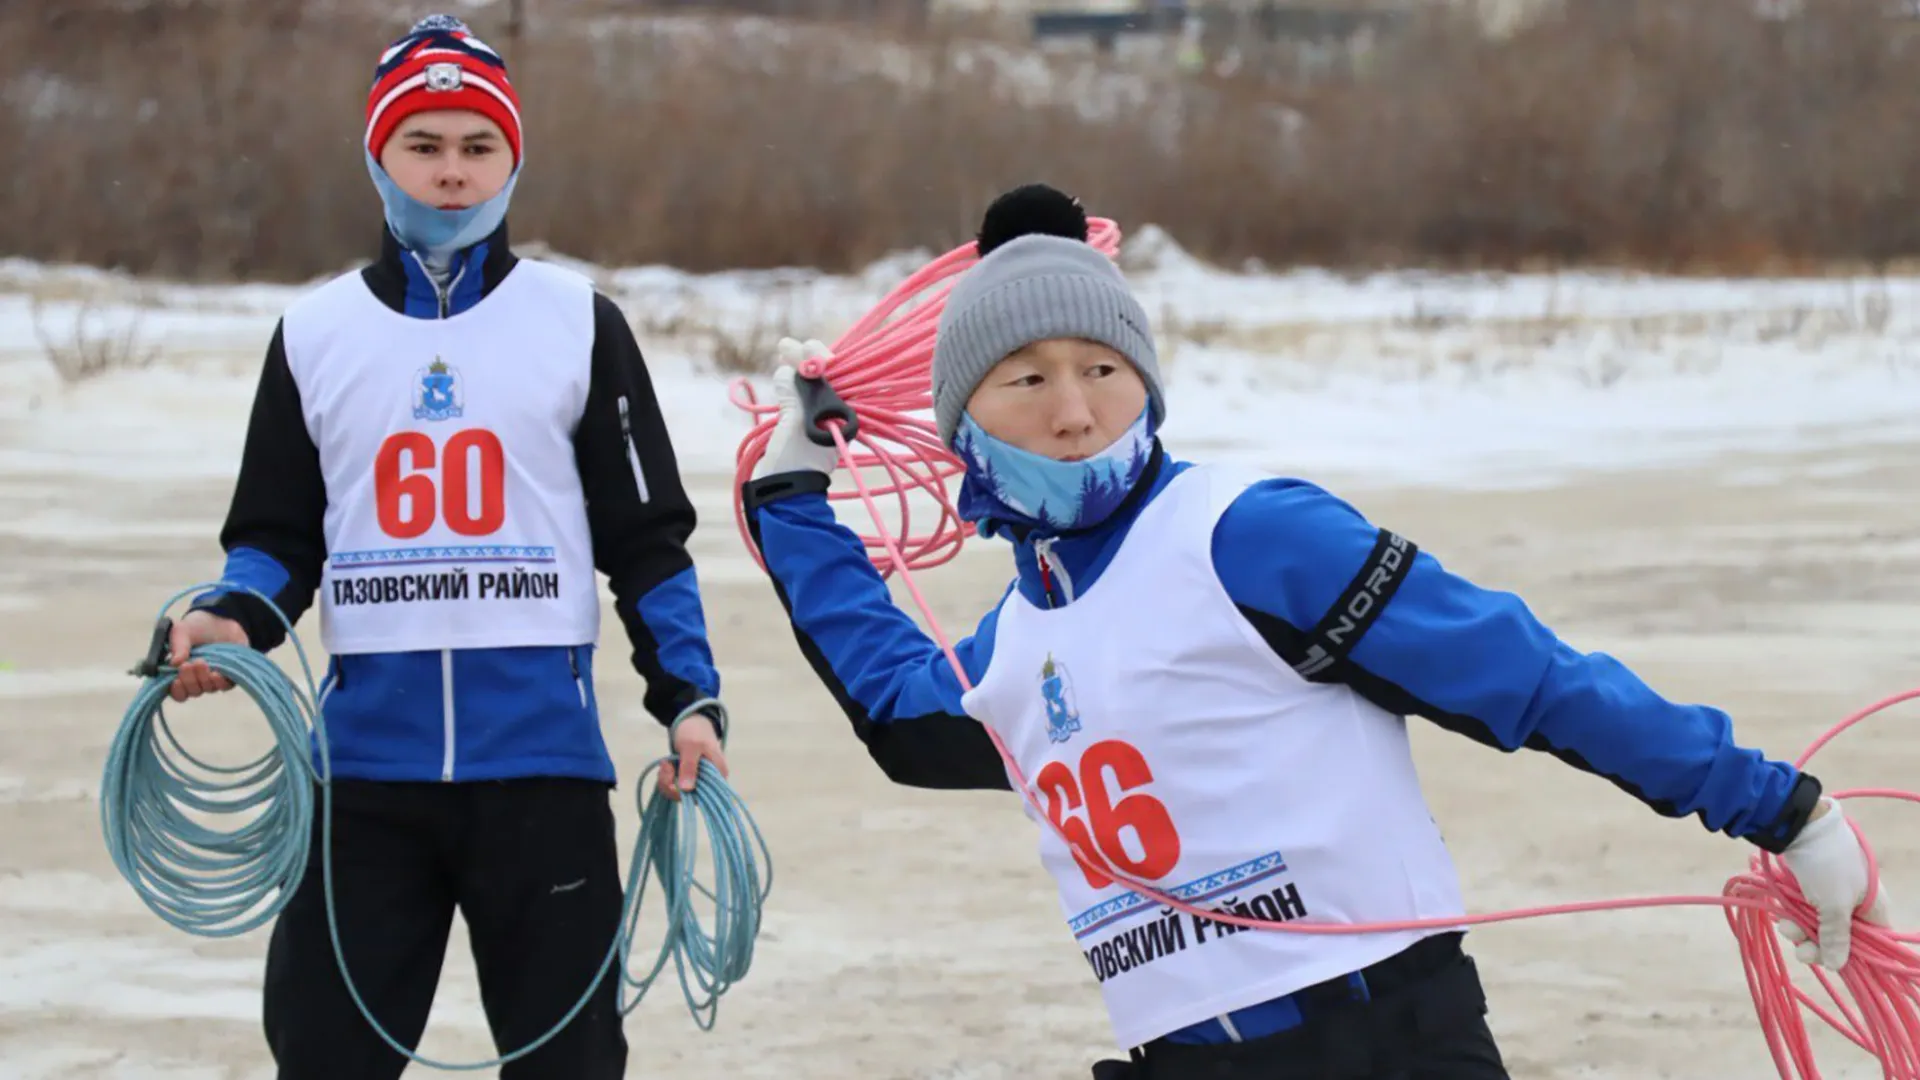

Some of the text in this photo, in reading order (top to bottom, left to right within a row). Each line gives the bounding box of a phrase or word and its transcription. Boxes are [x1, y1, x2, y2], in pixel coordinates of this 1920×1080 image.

[374, 428, 505, 540] 60
[332, 567, 560, 606] ТАЗОВСКИЙ РАЙОН
[1037, 739, 1181, 890] 66
[1083, 906, 1187, 983] ОВСКИЙ
